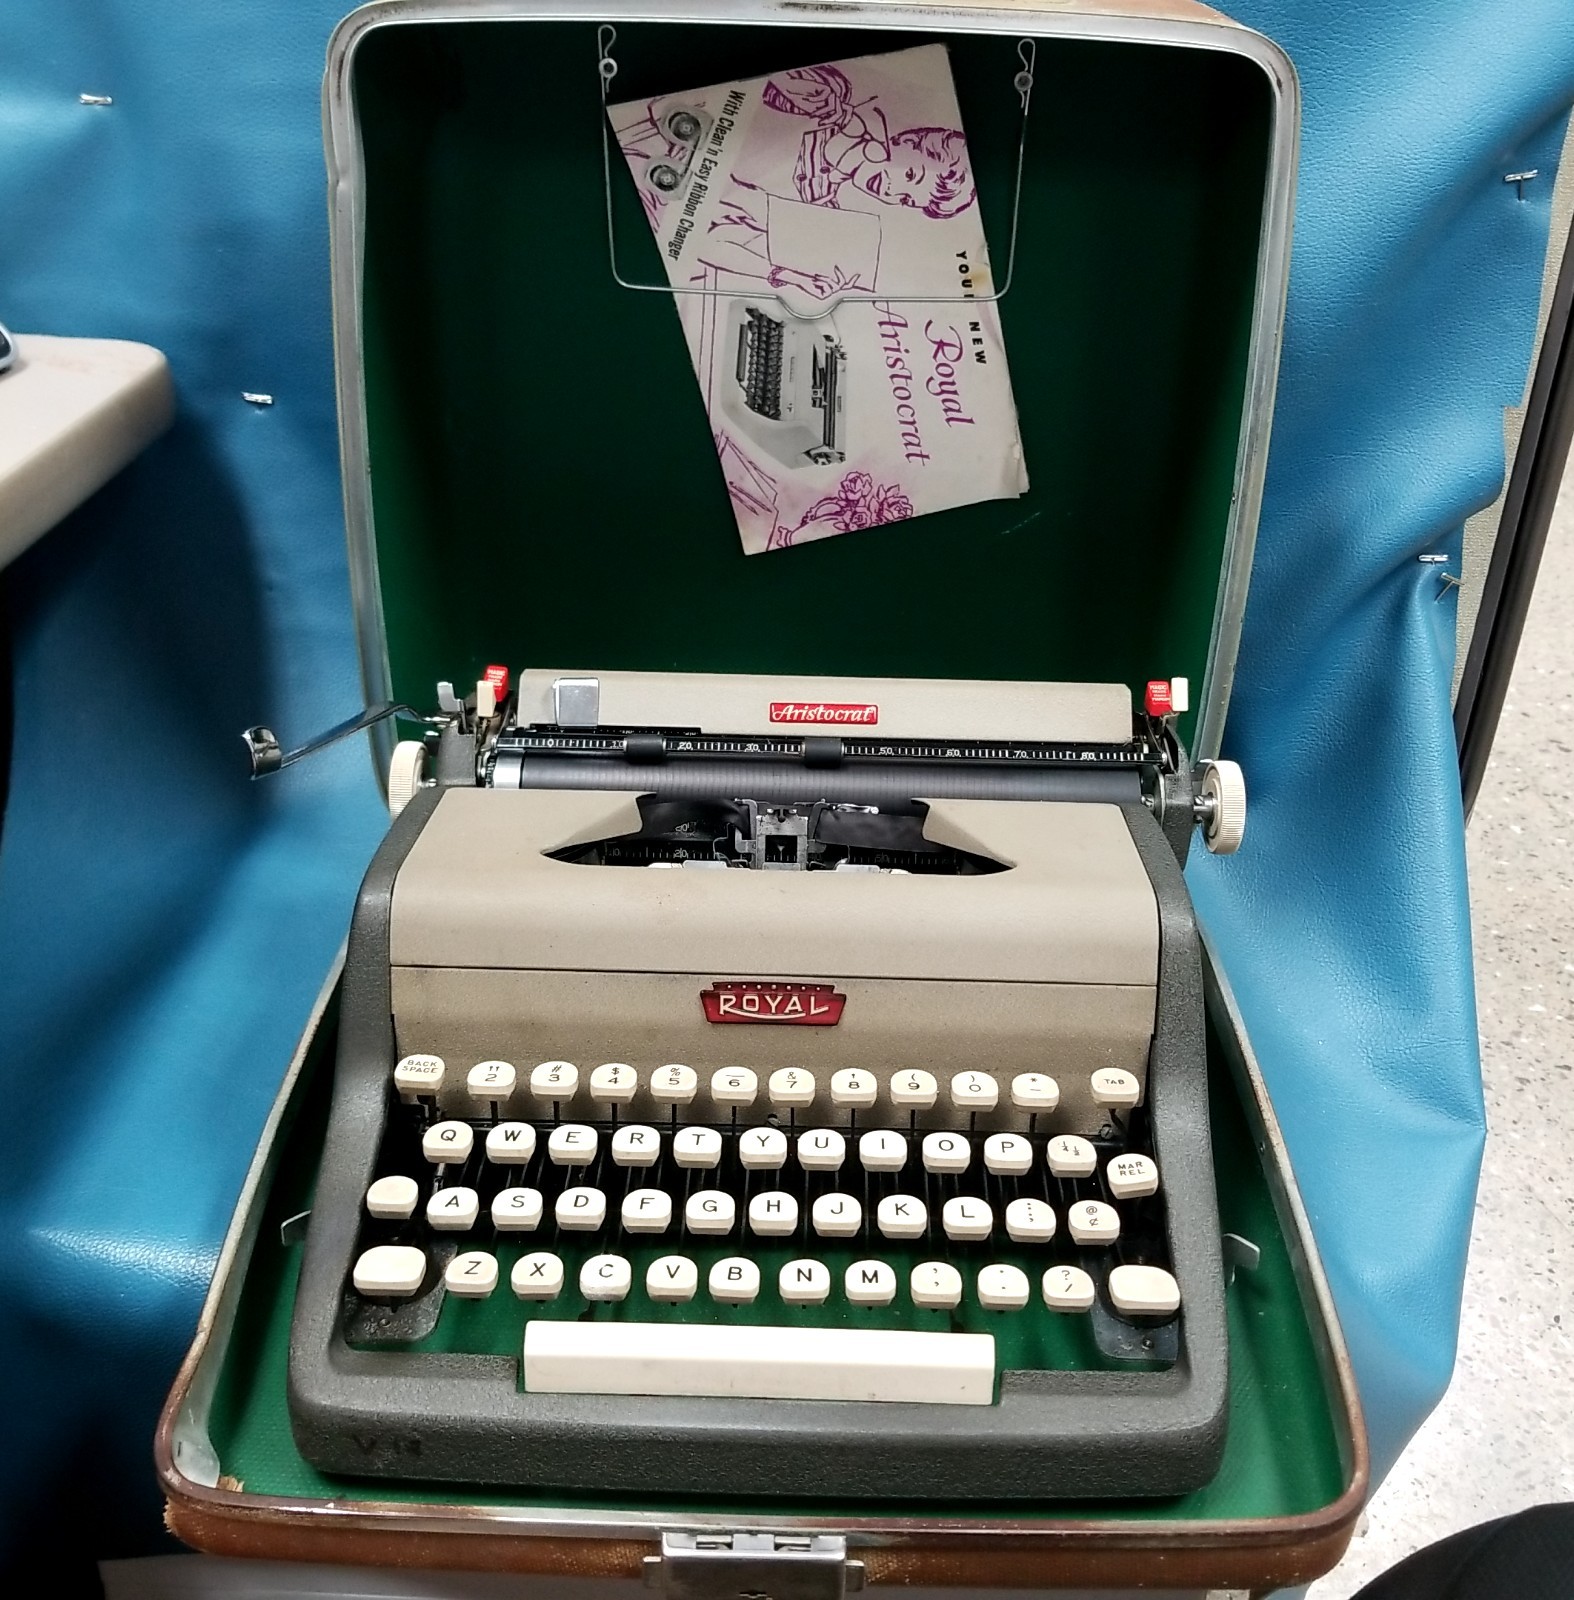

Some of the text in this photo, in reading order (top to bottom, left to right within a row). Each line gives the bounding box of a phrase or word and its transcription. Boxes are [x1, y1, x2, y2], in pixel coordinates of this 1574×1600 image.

[721, 90, 747, 117] With
[711, 115, 736, 148] Clean
[693, 157, 720, 186] Easy
[681, 179, 711, 220] Ribbon
[666, 217, 696, 262] Changer
[955, 250, 987, 365] YOU NEW
[924, 318, 976, 428] Royal
[872, 299, 931, 467] Aristocrat
[771, 704, 877, 723] Aristocrat
[680, 740, 692, 750] 20
[747, 743, 760, 753] 30
[879, 747, 893, 755] 50
[1014, 751, 1028, 759] 70
[1081, 752, 1096, 760] 80
[719, 994, 829, 1019] ROYAL
[401, 1065, 439, 1073] SPACE
[406, 1058, 438, 1067] BACK
[551, 1064, 563, 1073] #
[484, 1073, 498, 1082] 2
[548, 1073, 560, 1083] 3
[610, 1066, 620, 1076] $
[669, 1067, 681, 1077] %
[607, 1076, 619, 1085] 4
[668, 1077, 680, 1086] 5
[728, 1078, 741, 1088] 6
[786, 1080, 798, 1089] 7
[847, 1081, 861, 1090] 8
[907, 1081, 921, 1091] 9
[440, 1128, 457, 1142] Q
[504, 1129, 523, 1142] W
[565, 1131, 582, 1144] E
[629, 1132, 645, 1145] R
[691, 1133, 706, 1146] T
[756, 1135, 771, 1148] Y
[814, 1136, 829, 1149] U
[881, 1137, 886, 1150] I
[938, 1139, 955, 1152] O
[1000, 1141, 1015, 1154] P
[1117, 1161, 1144, 1170] MAR
[1118, 1169, 1146, 1177] REL
[444, 1194, 460, 1208] A
[510, 1194, 525, 1209] S
[573, 1194, 590, 1208] D
[639, 1197, 656, 1210] F
[702, 1199, 718, 1213] G
[766, 1199, 781, 1213] H
[830, 1201, 844, 1215] J
[894, 1202, 910, 1216] K
[960, 1204, 976, 1219] L
[463, 1260, 483, 1275] Z
[529, 1262, 547, 1277] X
[598, 1263, 614, 1279] C
[665, 1264, 681, 1279] V
[727, 1266, 743, 1281] B
[796, 1267, 813, 1283] N
[861, 1269, 879, 1284] M
